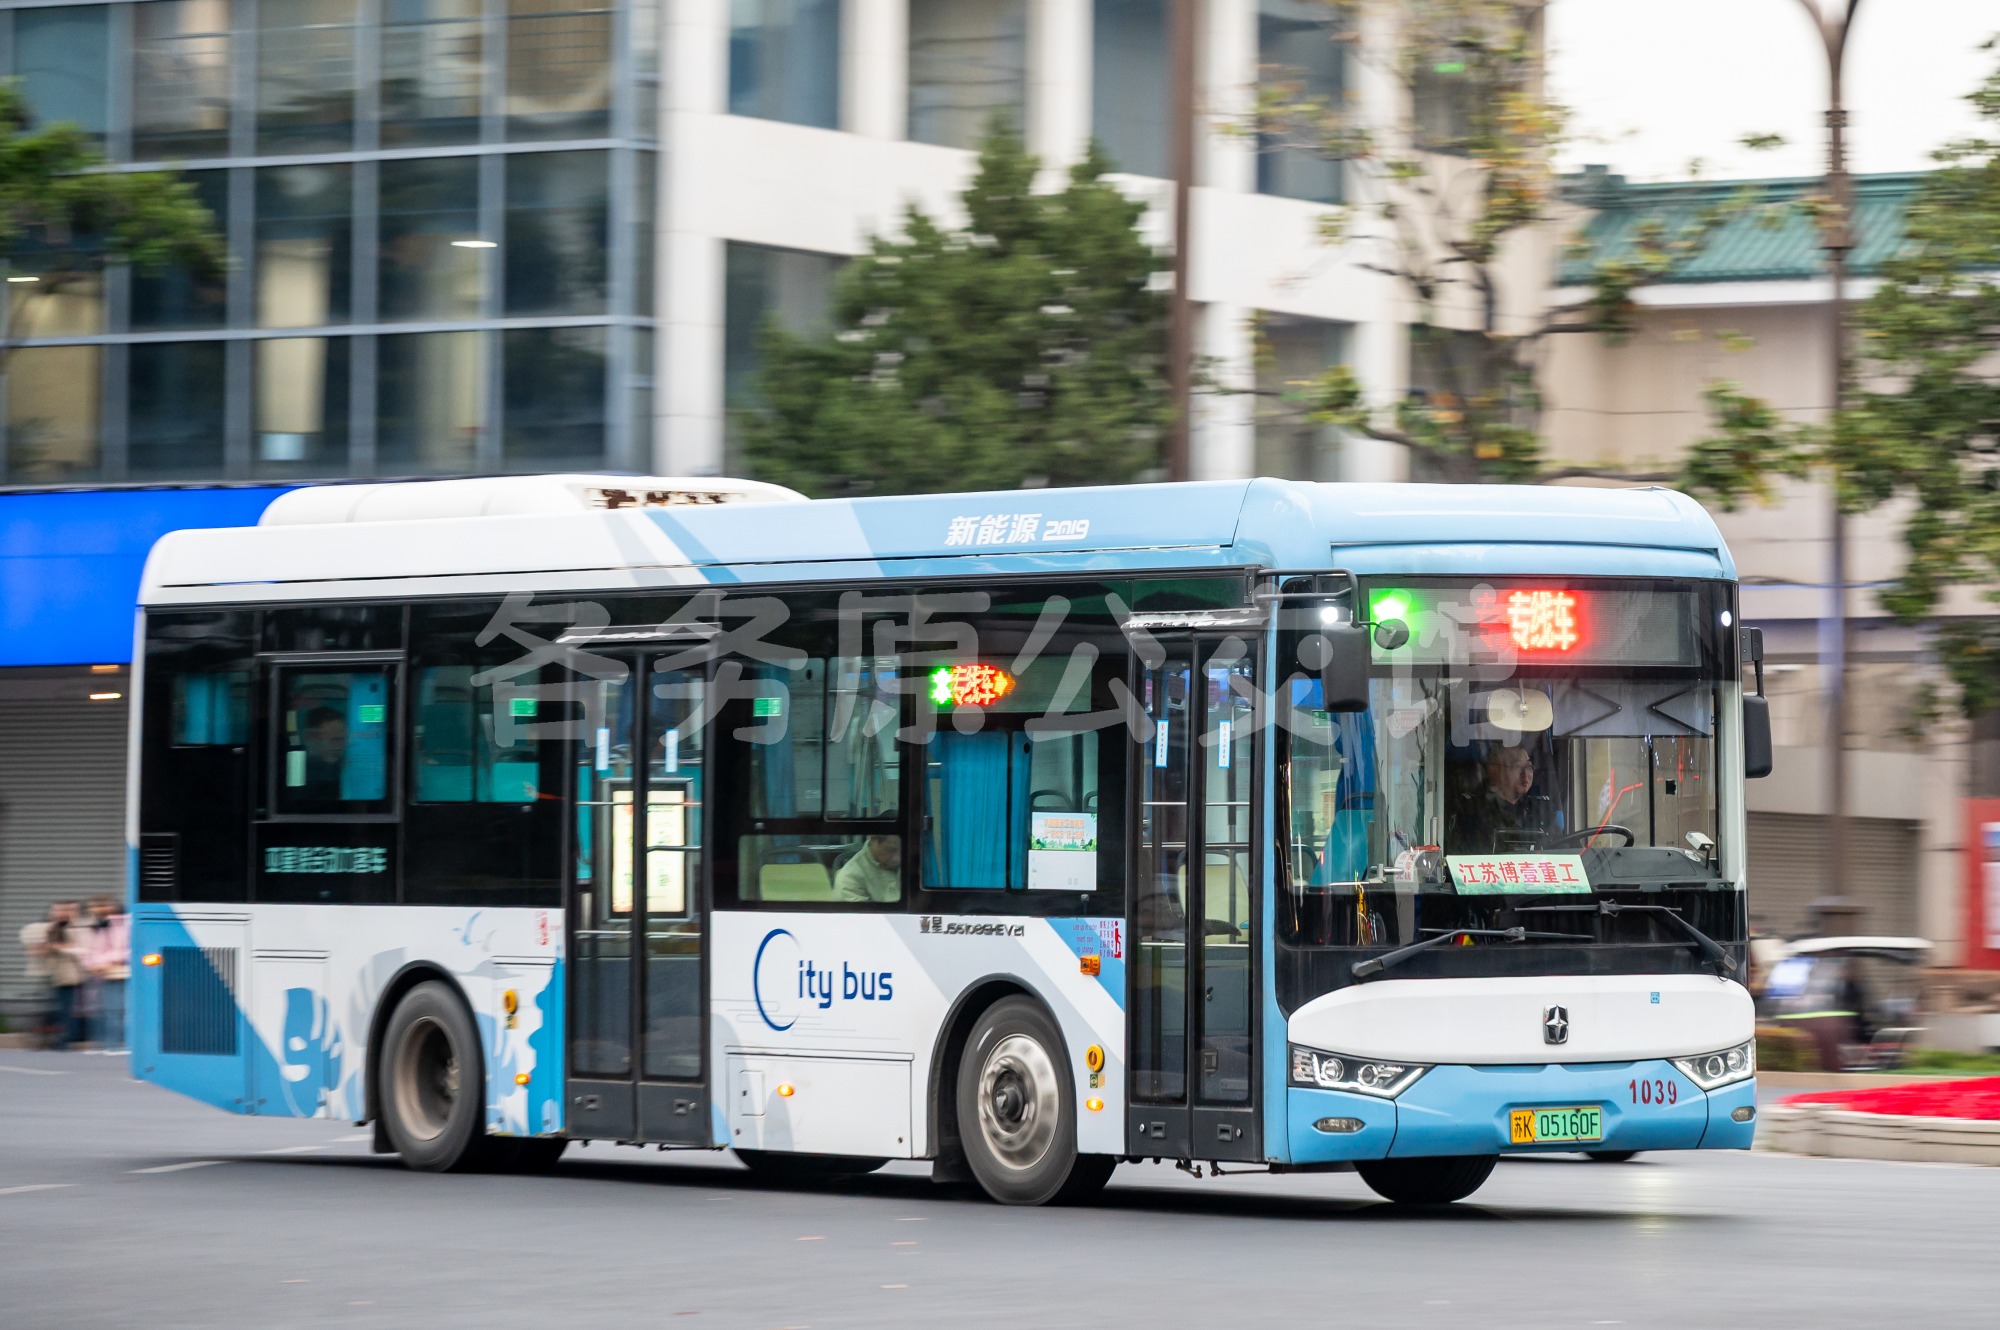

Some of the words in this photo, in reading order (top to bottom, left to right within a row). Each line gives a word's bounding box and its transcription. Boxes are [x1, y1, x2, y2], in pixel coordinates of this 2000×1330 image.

[944, 513, 1042, 546] 新能源
[1042, 519, 1090, 541] 2019
[1506, 591, 1578, 651] 专线车
[952, 665, 996, 706] 专线车
[1458, 861, 1580, 884] 江苏博壹重工
[753, 928, 833, 1032] City
[843, 960, 893, 1001] bus
[1629, 1079, 1678, 1105] 1039
